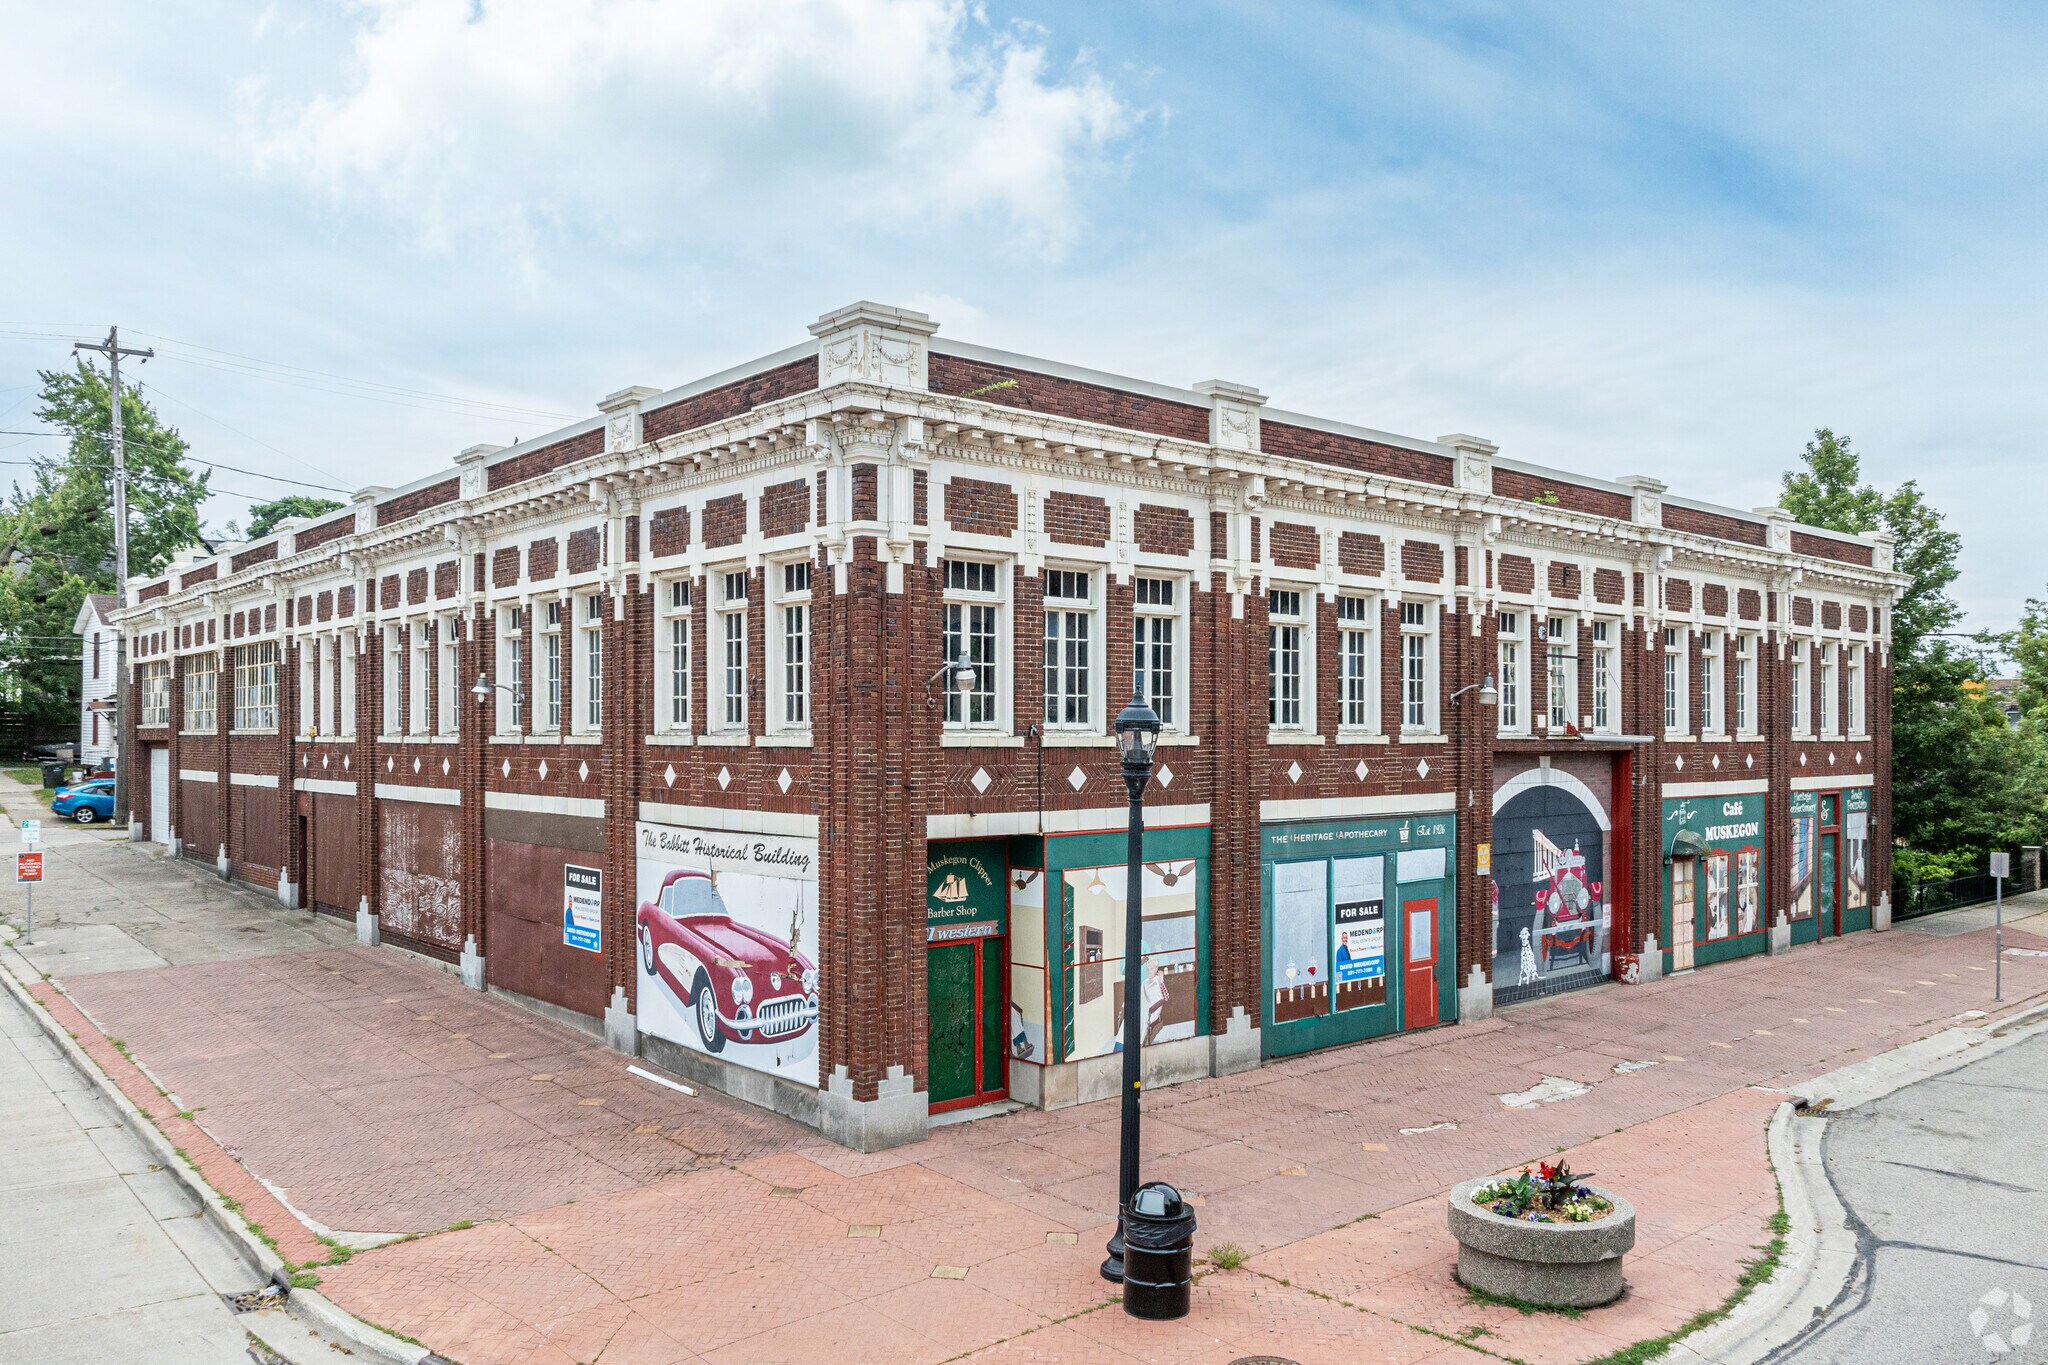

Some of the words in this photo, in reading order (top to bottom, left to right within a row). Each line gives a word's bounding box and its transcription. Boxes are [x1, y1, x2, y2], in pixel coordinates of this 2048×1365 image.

[1851, 788, 1863, 800] Soda
[1723, 801, 1743, 816] Café
[1820, 800, 1830, 821] &
[22, 820, 29, 828] 2
[1705, 822, 1759, 841] MUSKEGON
[1271, 835, 1288, 844] THE
[1290, 832, 1334, 842] HERITAGE
[1336, 829, 1388, 840] APOTHECARY
[642, 829, 657, 848] The
[659, 832, 690, 854] Babbitt
[692, 836, 748, 861] Historical
[753, 843, 811, 873] Building
[927, 855, 968, 874] Muskegon
[969, 857, 993, 887] Clipper
[568, 872, 580, 883] FOR
[581, 875, 597, 886] SALE
[927, 907, 954, 919] Barber
[956, 905, 978, 917] Shop
[1340, 908, 1357, 918] FOR
[1359, 905, 1378, 917] SALE
[937, 925, 992, 940] western
